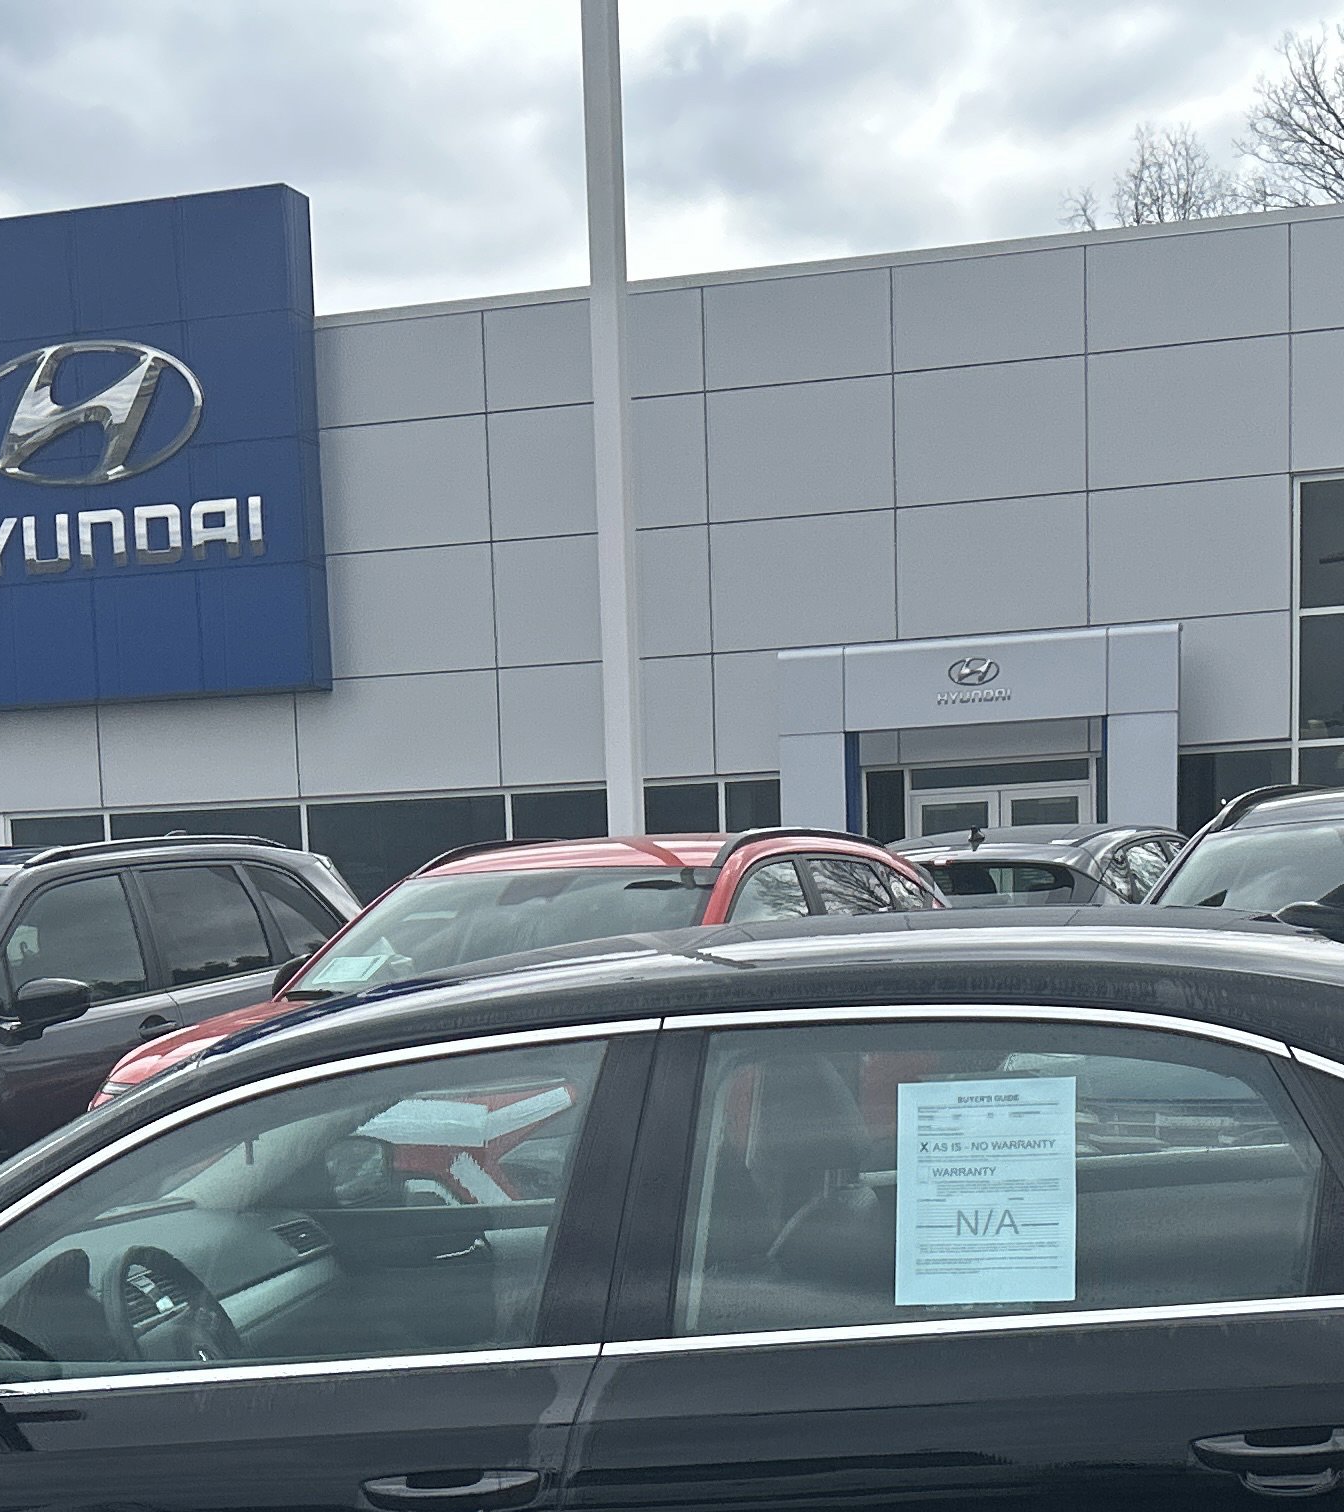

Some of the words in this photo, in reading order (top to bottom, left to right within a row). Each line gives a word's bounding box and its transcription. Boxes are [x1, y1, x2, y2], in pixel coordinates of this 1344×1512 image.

[937, 688, 1011, 705] HYUNDAI
[932, 1143, 948, 1152] AS
[951, 1142, 962, 1152] IS
[970, 1142, 989, 1151] NO
[991, 1139, 1056, 1151] WARRANTY
[932, 1166, 997, 1177] WARRANTY
[957, 1209, 1019, 1236] N/A
